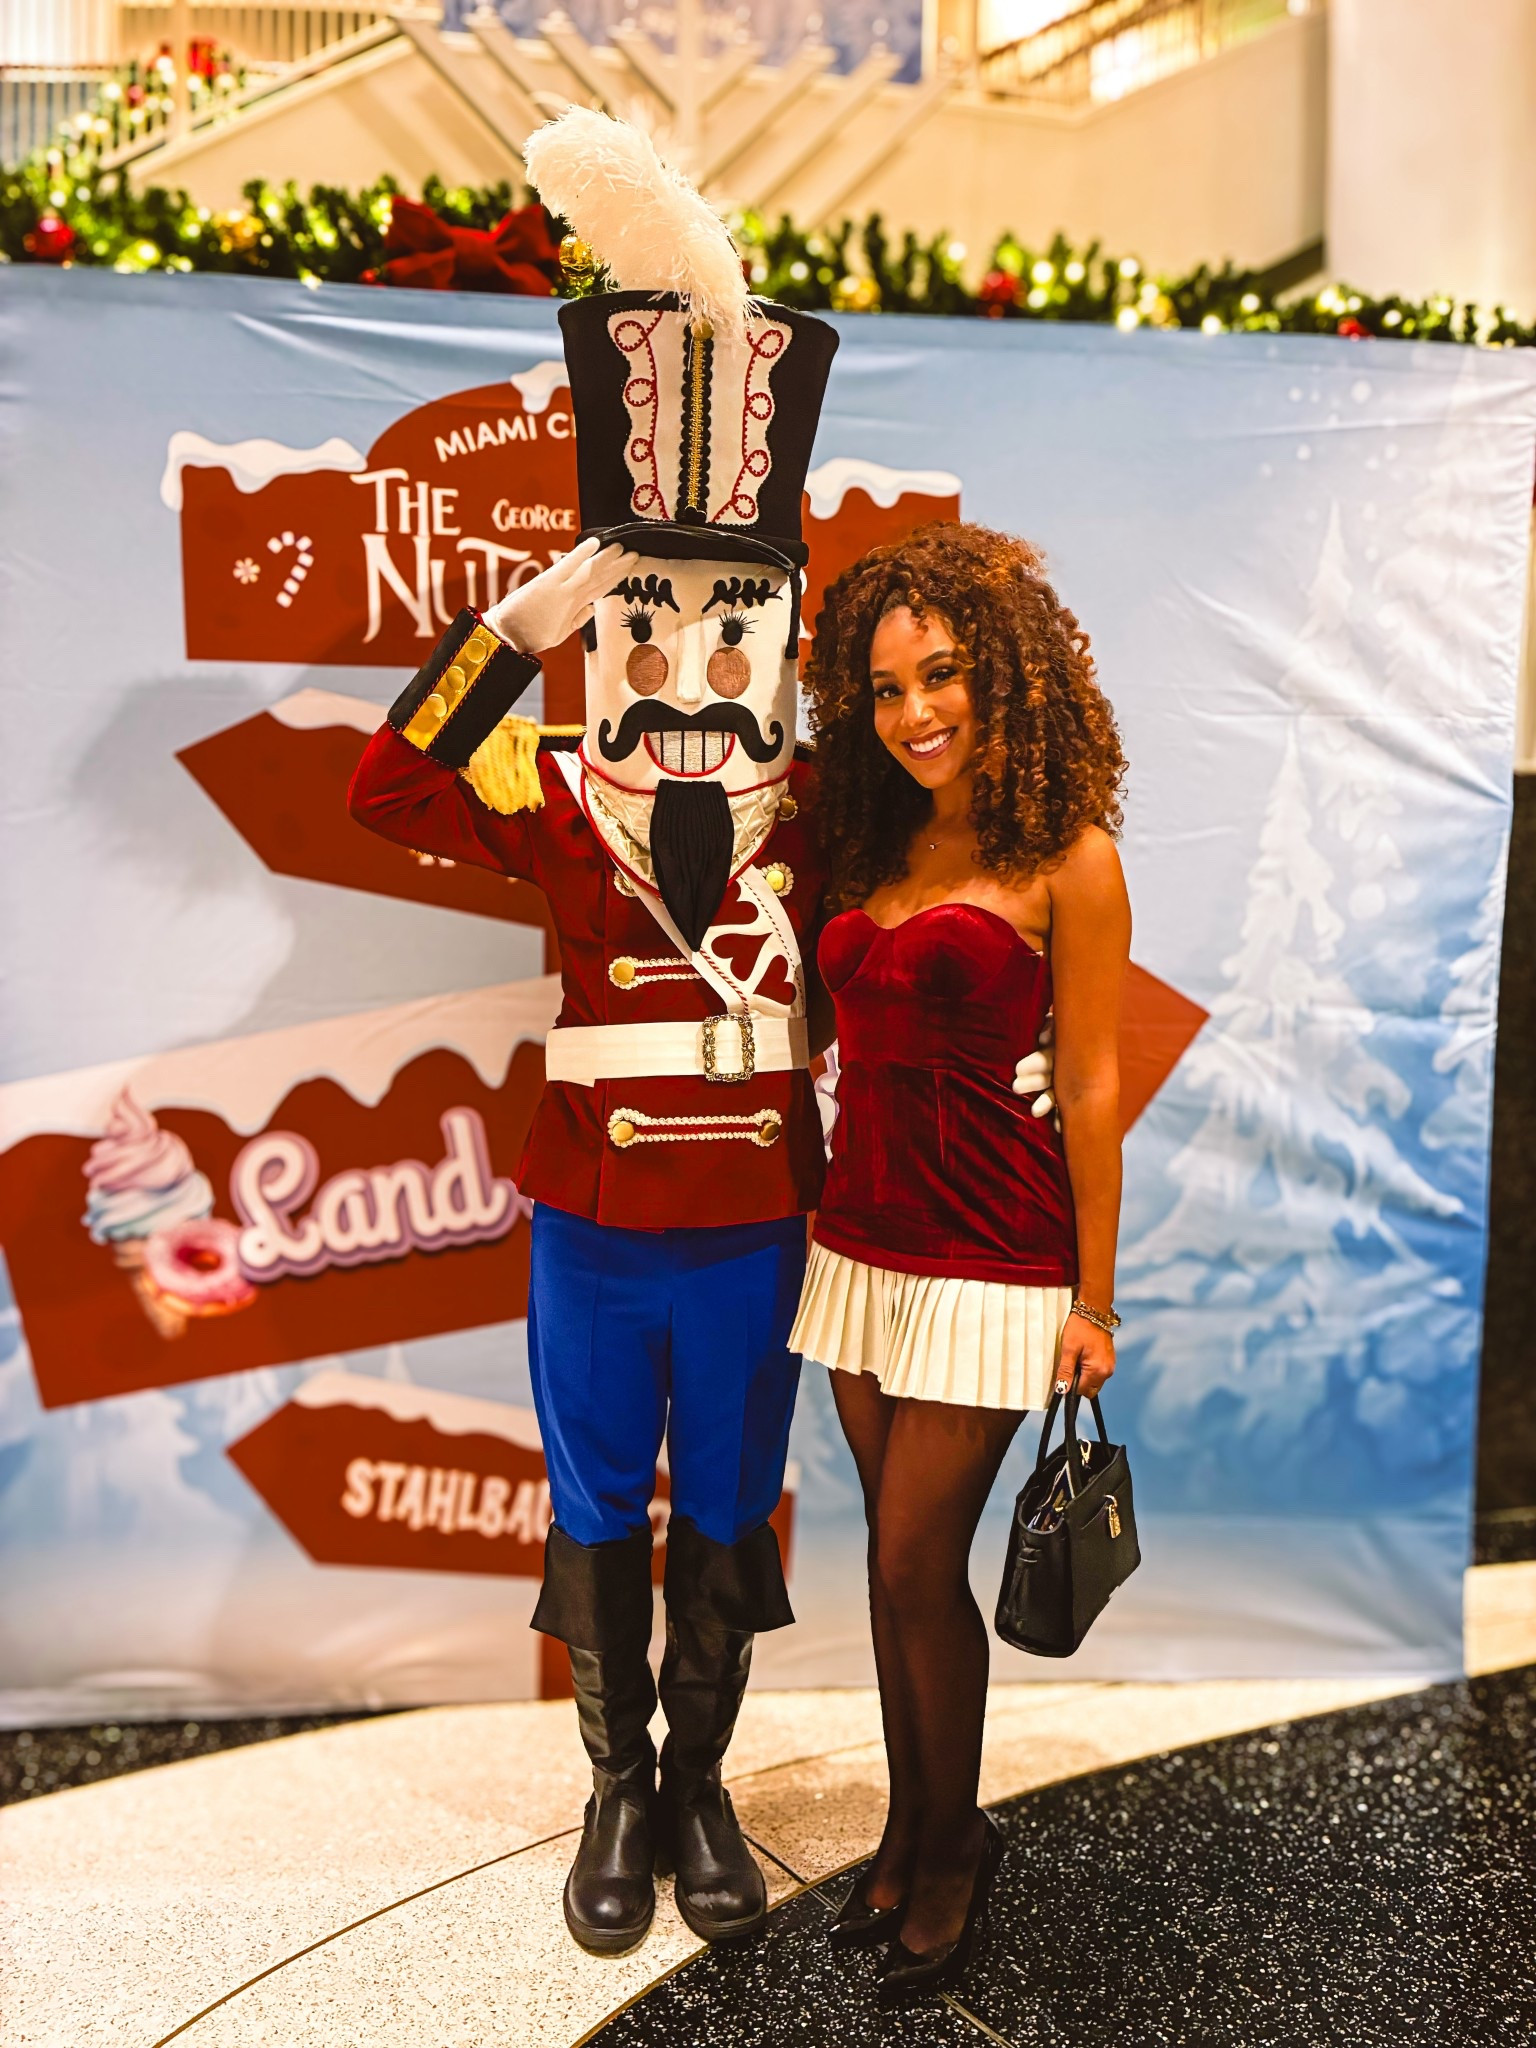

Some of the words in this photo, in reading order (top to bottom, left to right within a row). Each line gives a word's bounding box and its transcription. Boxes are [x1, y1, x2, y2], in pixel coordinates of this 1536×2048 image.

[434, 414, 538, 463] MIAMI
[349, 468, 461, 536] THE
[491, 498, 577, 532] GEORGE
[232, 1108, 517, 1279] Land
